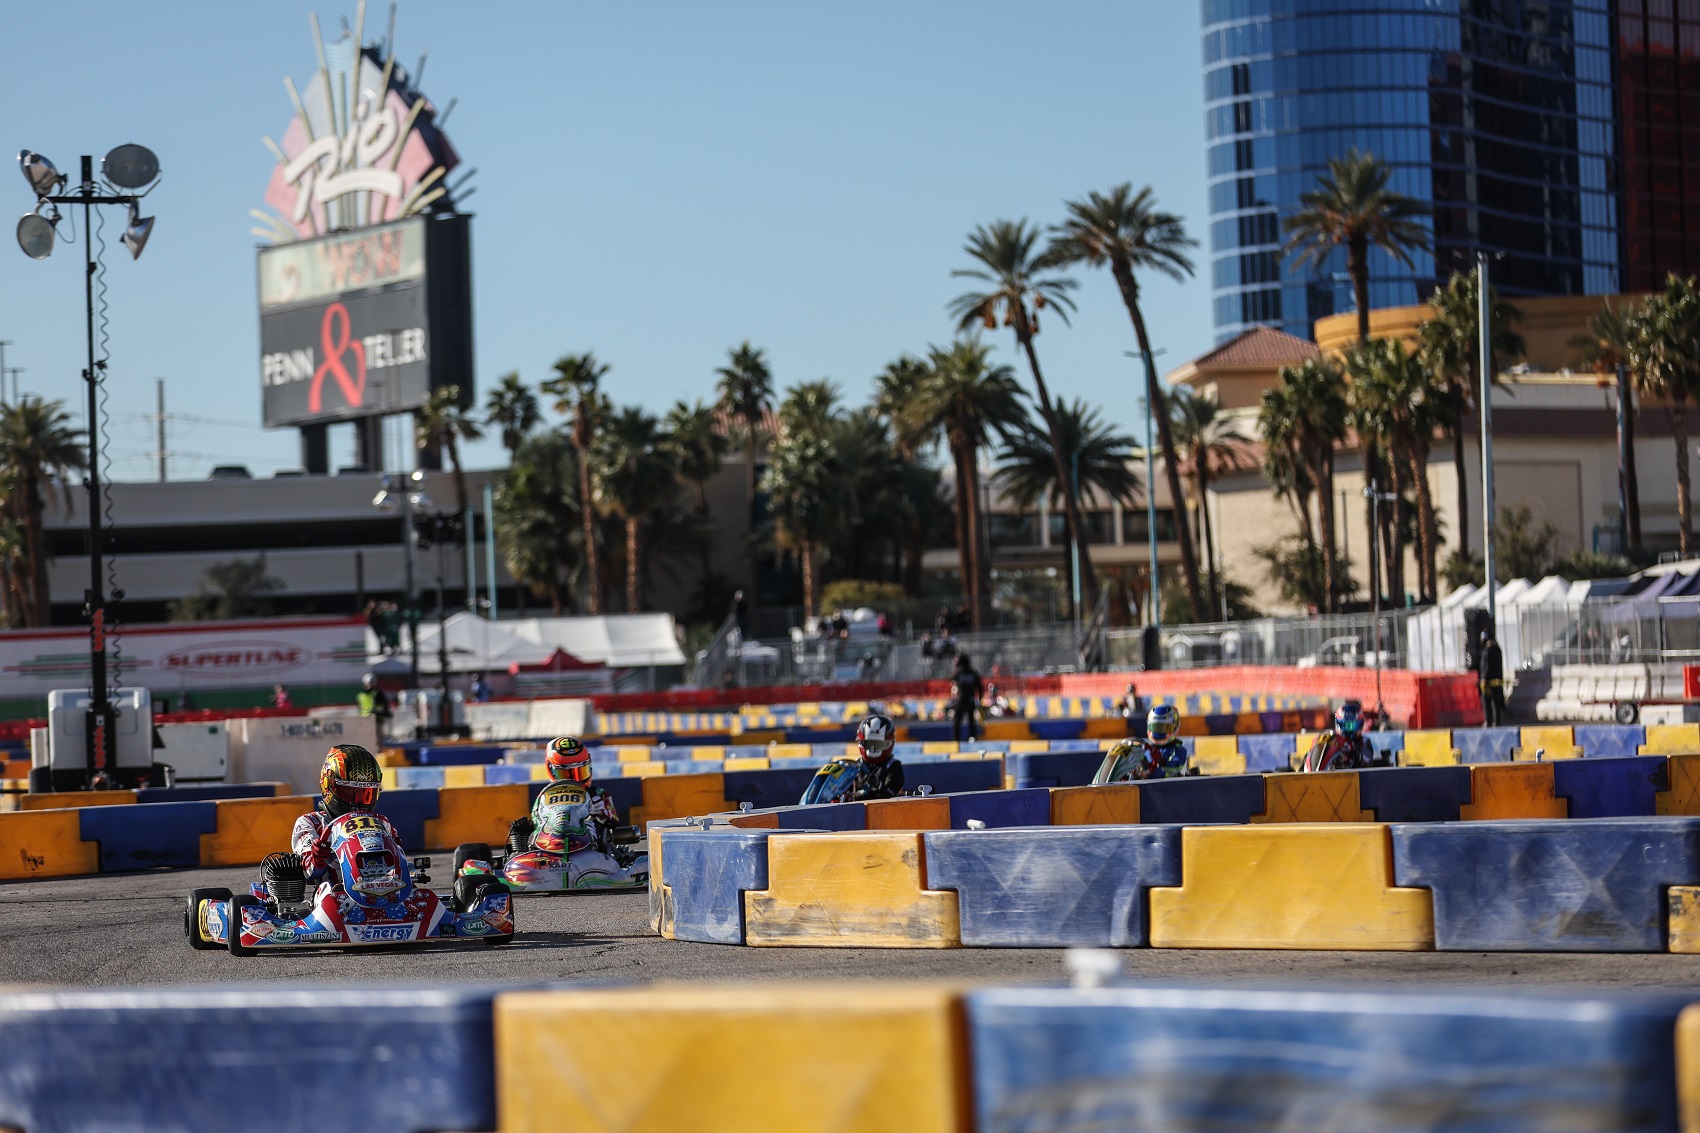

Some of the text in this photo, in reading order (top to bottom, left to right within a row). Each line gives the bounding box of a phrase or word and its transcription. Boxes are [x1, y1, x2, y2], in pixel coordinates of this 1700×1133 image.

[285, 102, 402, 224] Rio
[317, 229, 404, 287] WOW
[262, 302, 425, 413] PENN & TELLER
[549, 794, 581, 804] 806
[357, 923, 415, 941] Energy
